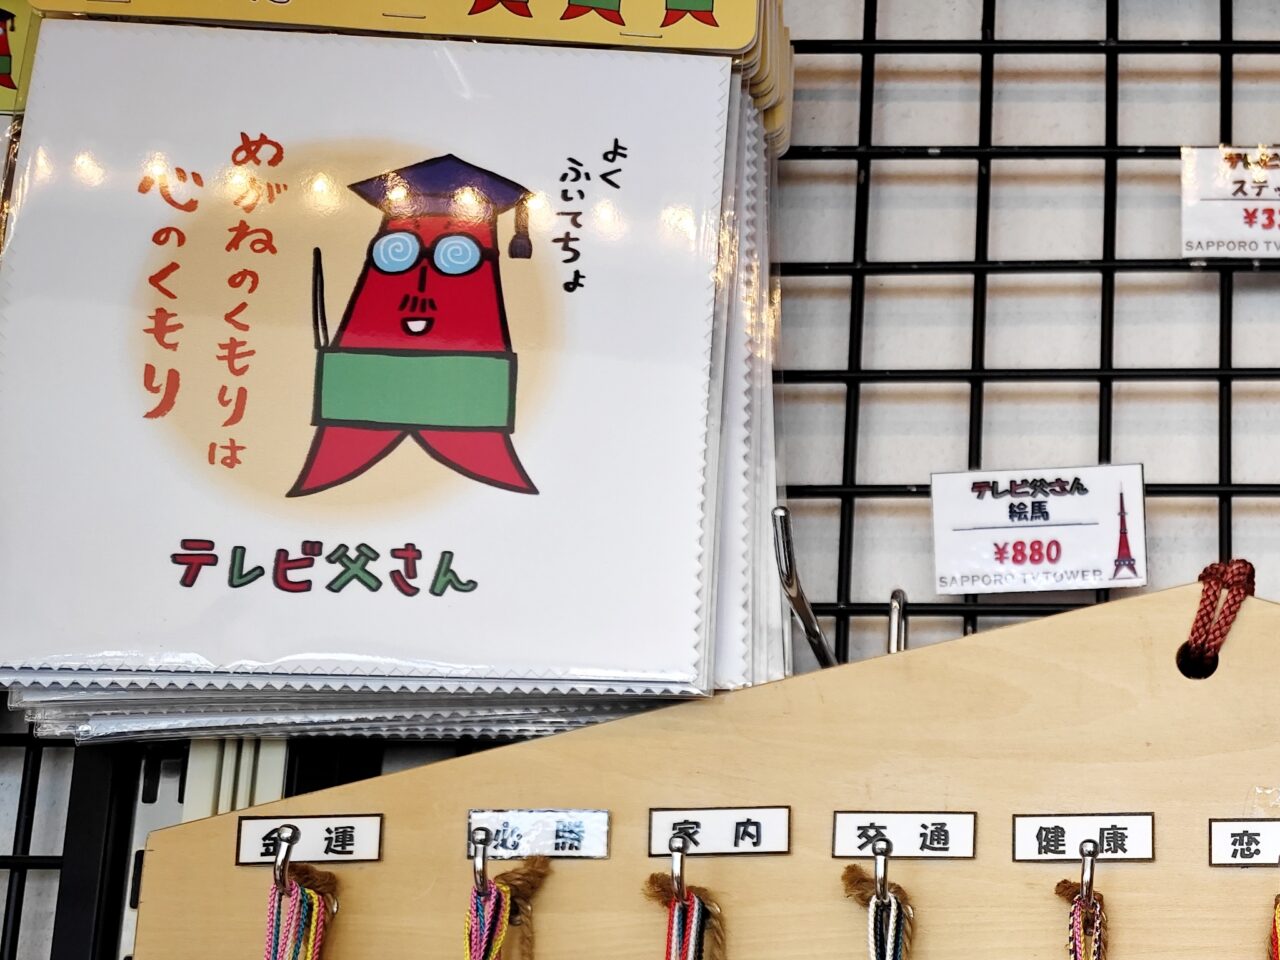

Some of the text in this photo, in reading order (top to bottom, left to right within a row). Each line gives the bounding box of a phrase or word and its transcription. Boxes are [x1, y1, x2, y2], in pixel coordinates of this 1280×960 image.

[601, 138, 628, 189] よく
[552, 157, 590, 294] ふいてちょ
[1185, 241, 1259, 252] SAPPORO
[136, 165, 205, 420] 心のくもり
[208, 131, 285, 469] めがねのくもりは
[971, 477, 1089, 500] テレビ父さん
[1008, 501, 1050, 522] 絵馬
[993, 540, 1062, 565] ¥880
[171, 538, 479, 597] テレビ父さん
[939, 574, 1014, 588] SAPPORO
[672, 819, 761, 848] 家内
[857, 822, 950, 852] 交通
[1036, 825, 1127, 854] 健康
